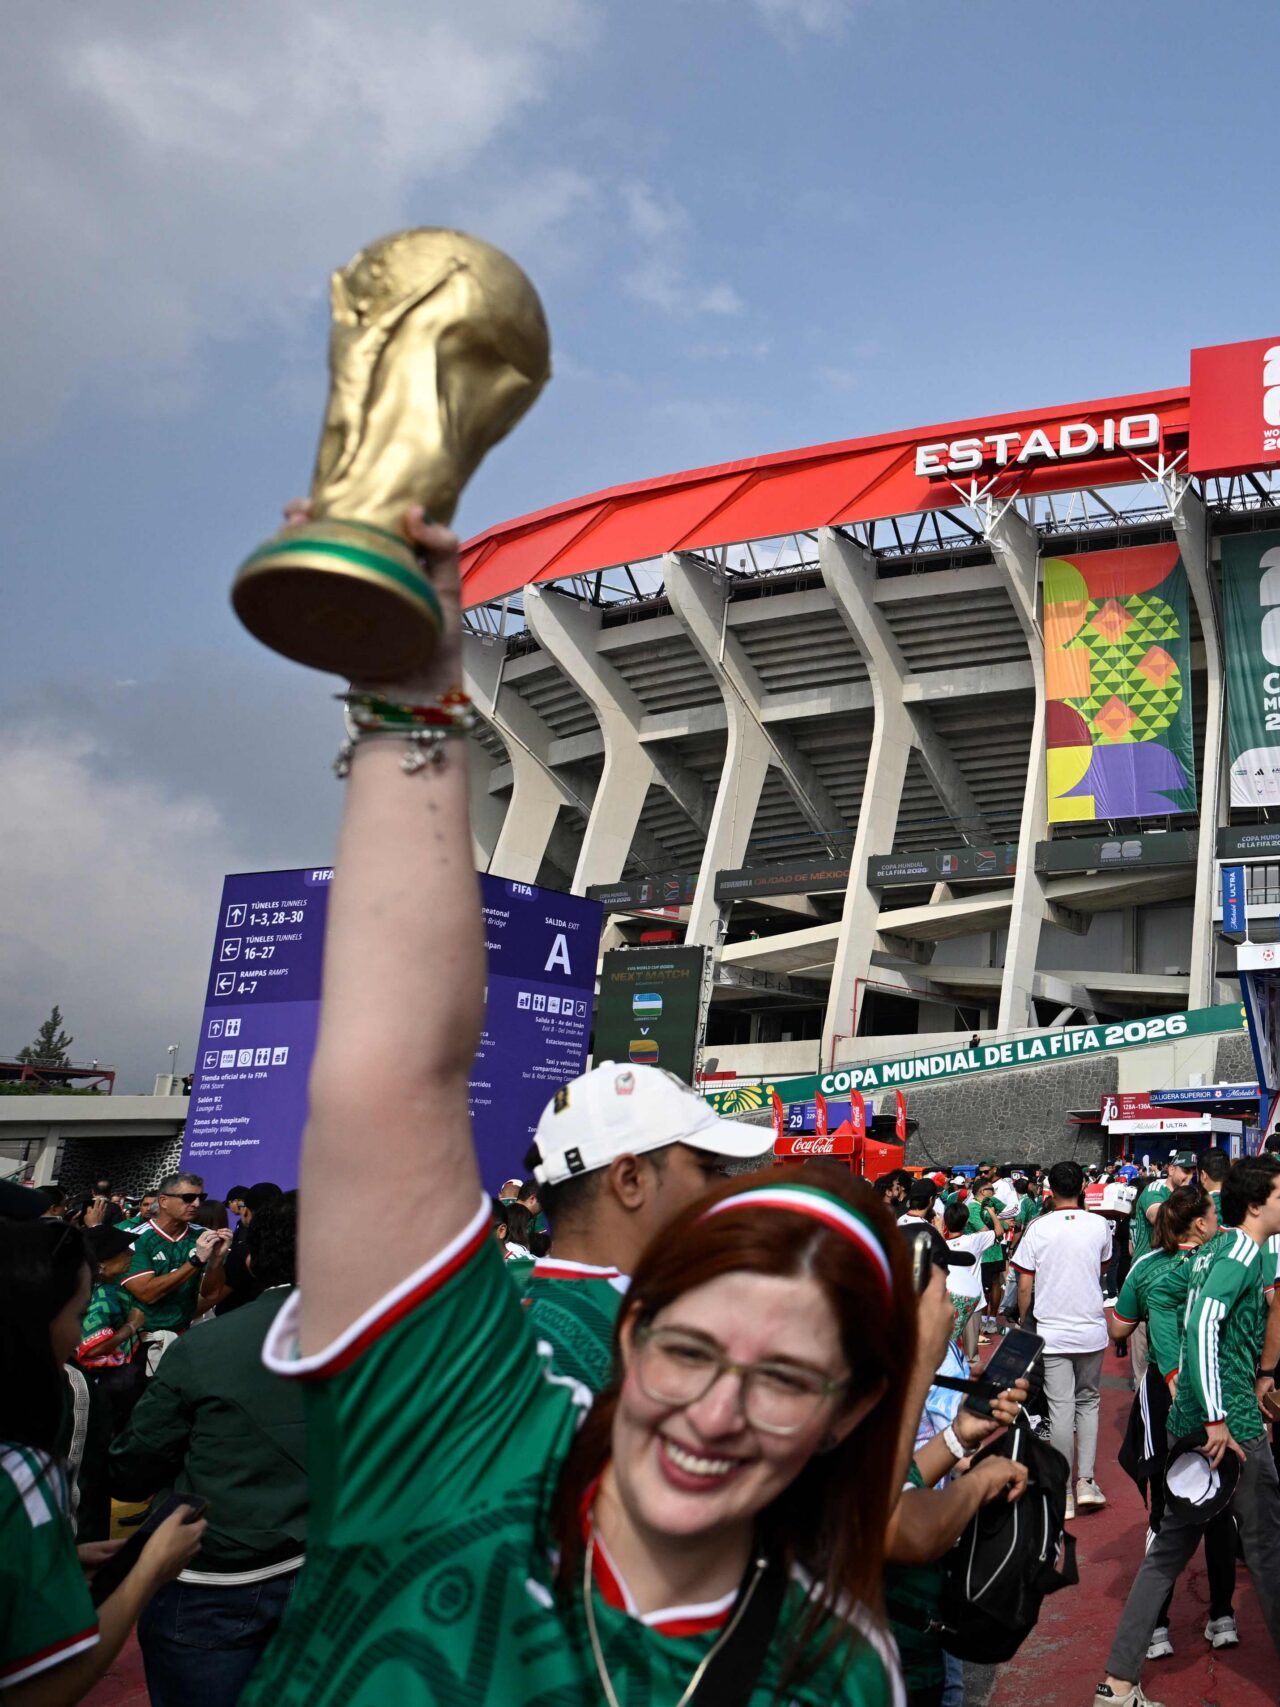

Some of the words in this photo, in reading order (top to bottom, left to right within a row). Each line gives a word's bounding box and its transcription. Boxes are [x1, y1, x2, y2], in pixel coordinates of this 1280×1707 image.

[915, 412, 1160, 477] ESTADIO
[312, 870, 334, 881] FIFA
[755, 875, 792, 885] CIUDAD
[793, 873, 808, 881] DE
[810, 869, 850, 881] MÉXICO
[512, 883, 532, 896] FIFA
[251, 901, 279, 910] TÚNELES
[281, 899, 308, 908] TUNNELS
[482, 907, 509, 918] peatonal
[487, 917, 507, 928] Bridge
[545, 917, 567, 928] SALIDA
[567, 922, 580, 930] EXIT
[246, 934, 274, 944] TÚNELES
[275, 933, 302, 942] TUNNELS
[544, 933, 572, 975] A
[240, 970, 267, 978] RAMPAS
[268, 968, 289, 976] RAMPS
[611, 972, 643, 982] NEXT
[646, 969, 690, 979] MATCH
[545, 1038, 582, 1048] Estacionamiento
[820, 1065, 879, 1094] COPA
[882, 1048, 980, 1083] MUNDIAL
[985, 1043, 1013, 1065] DE
[1017, 1038, 1047, 1061] LA
[1049, 1029, 1100, 1055] FIFA
[1105, 1014, 1188, 1045] 2026
[532, 1066, 561, 1074] compartidos
[562, 1067, 579, 1075] Cantera
[1159, 1092, 1179, 1101] LIGERA
[1180, 1091, 1211, 1099] SUPERIOR
[219, 1117, 250, 1126] hospitality
[789, 1115, 803, 1128] 29
[220, 1126, 237, 1134] Village
[224, 1139, 260, 1147] trabajadores
[189, 1149, 213, 1157] Workforce
